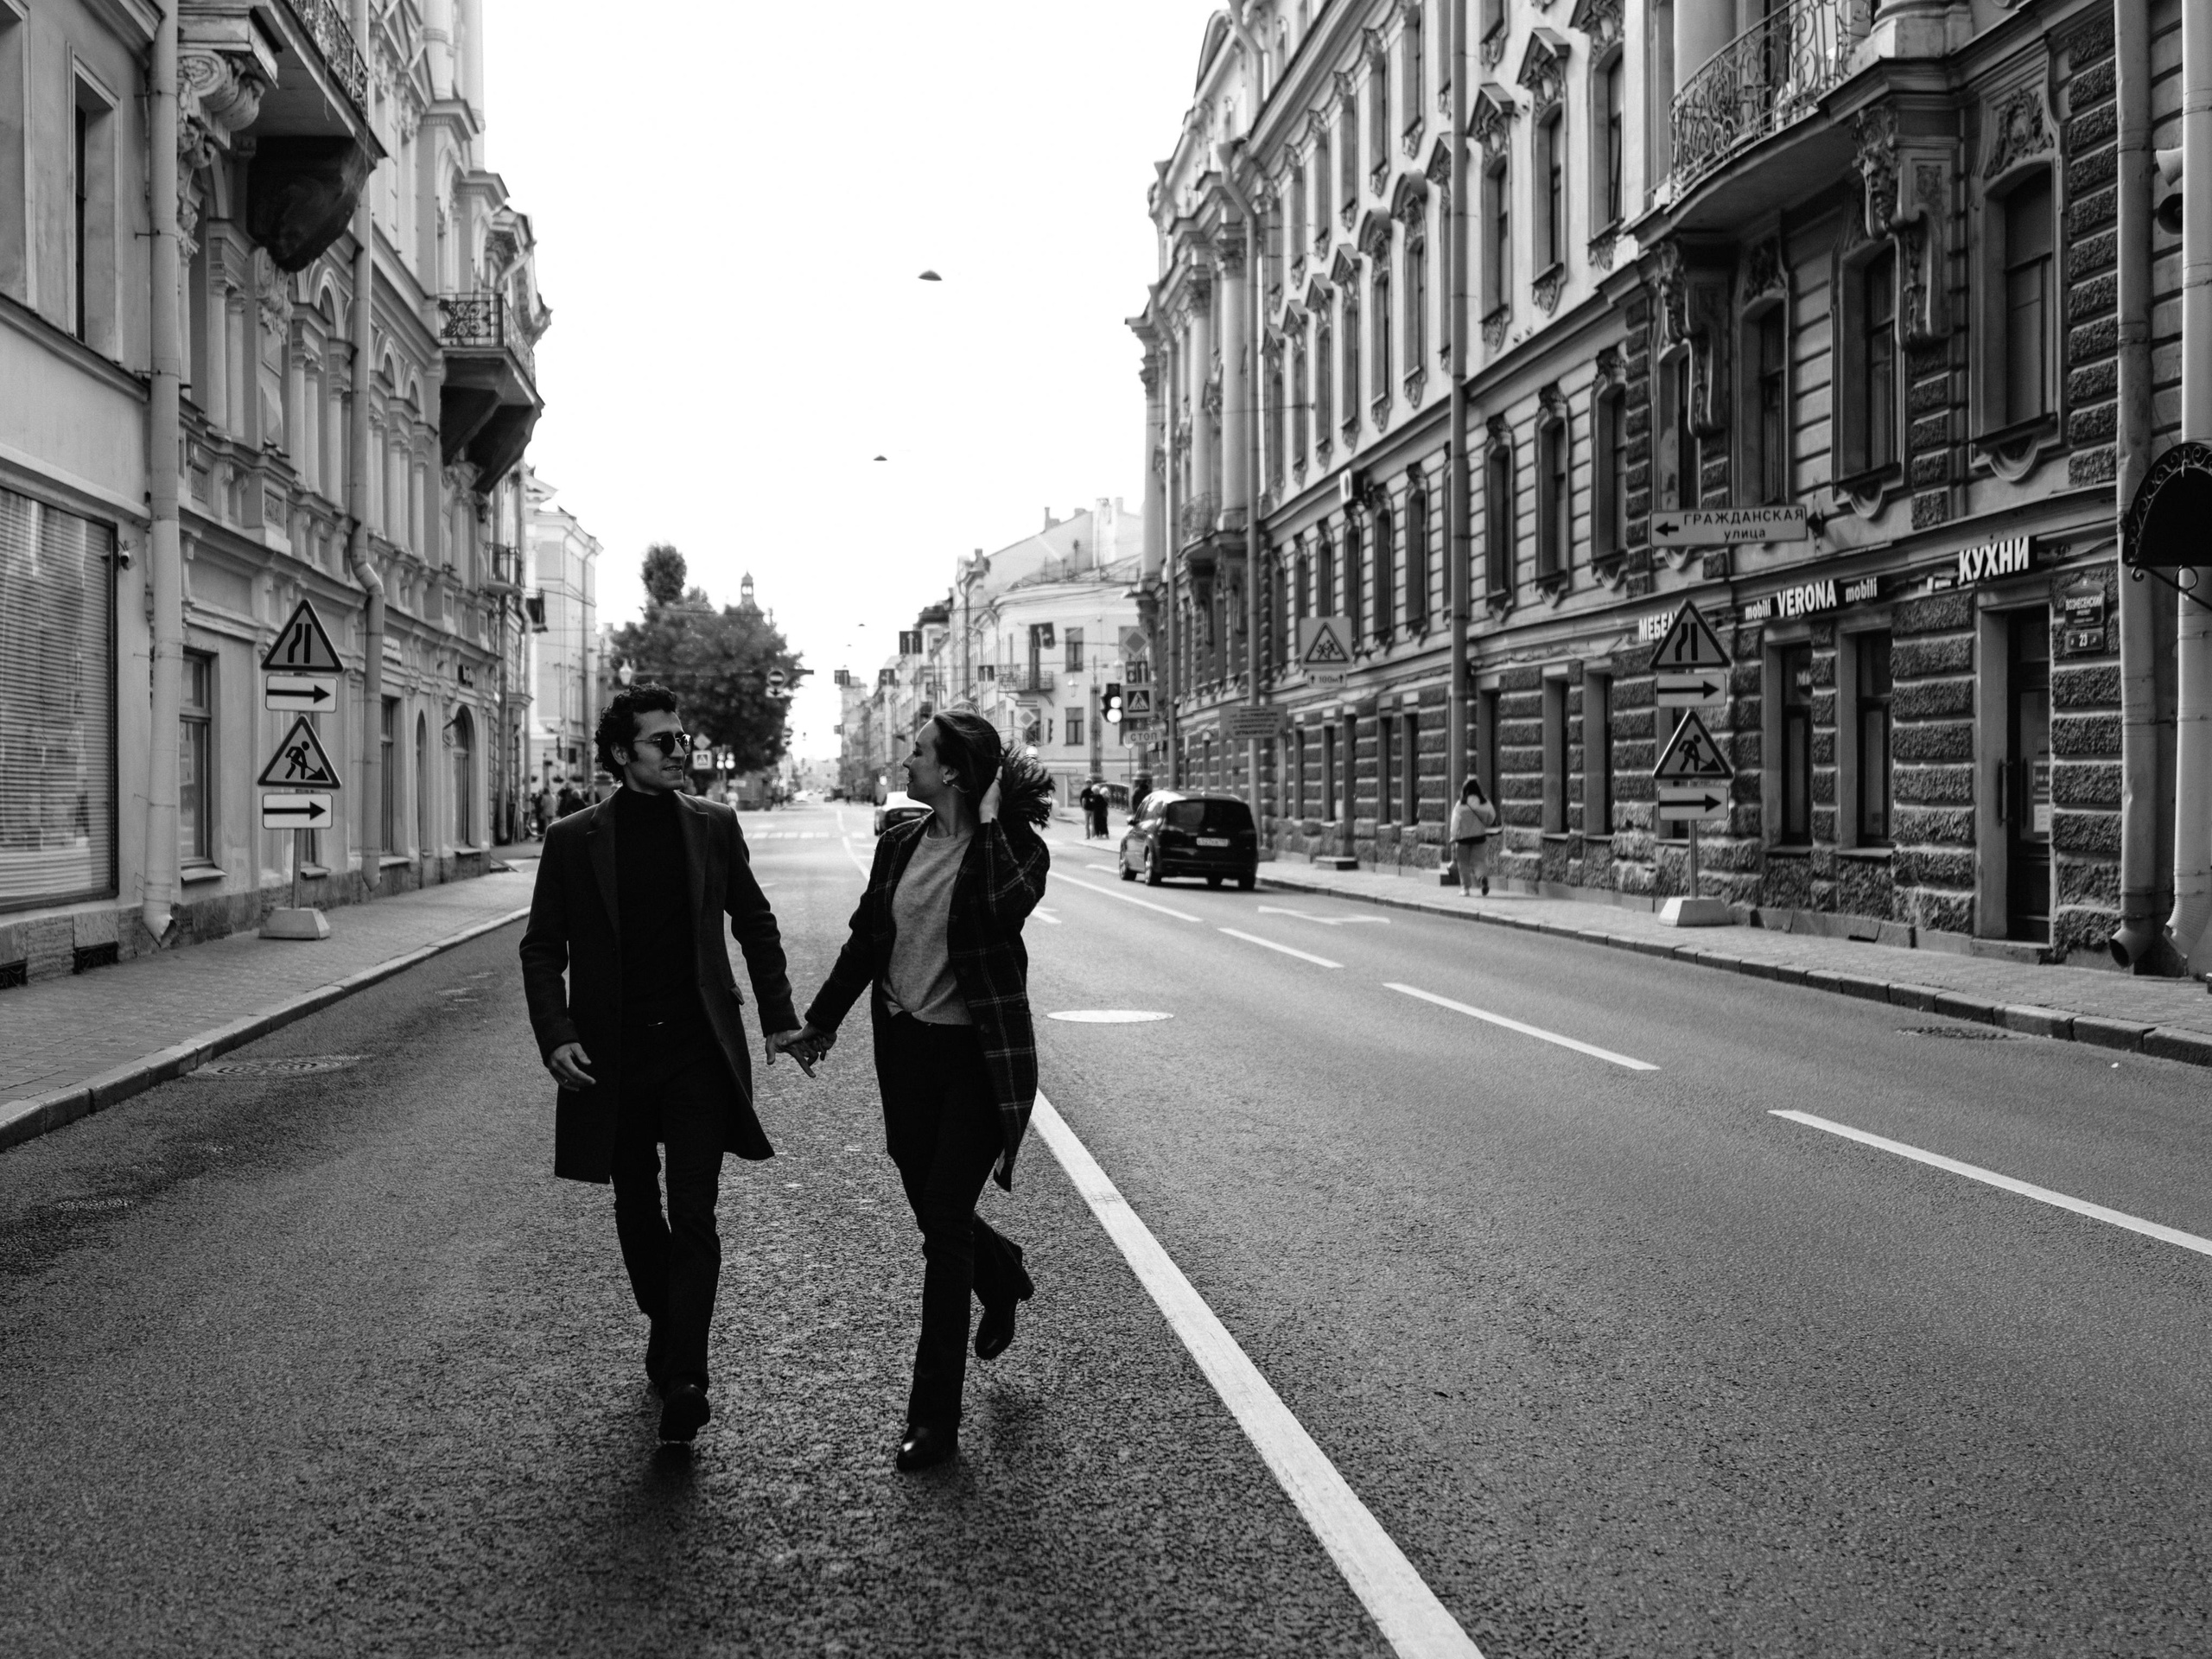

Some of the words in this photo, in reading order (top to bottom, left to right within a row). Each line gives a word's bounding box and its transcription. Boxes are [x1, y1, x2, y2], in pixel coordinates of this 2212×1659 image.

[1683, 508, 1803, 525] ГРАЖДАНСКАЯ
[1724, 529, 1766, 544] улица
[1958, 536, 2030, 583] КУХНИ
[1745, 599, 1771, 620] mobili
[1777, 579, 1837, 618] VERONA
[1845, 576, 1878, 603] mobili
[1130, 732, 1158, 741] СТОП
